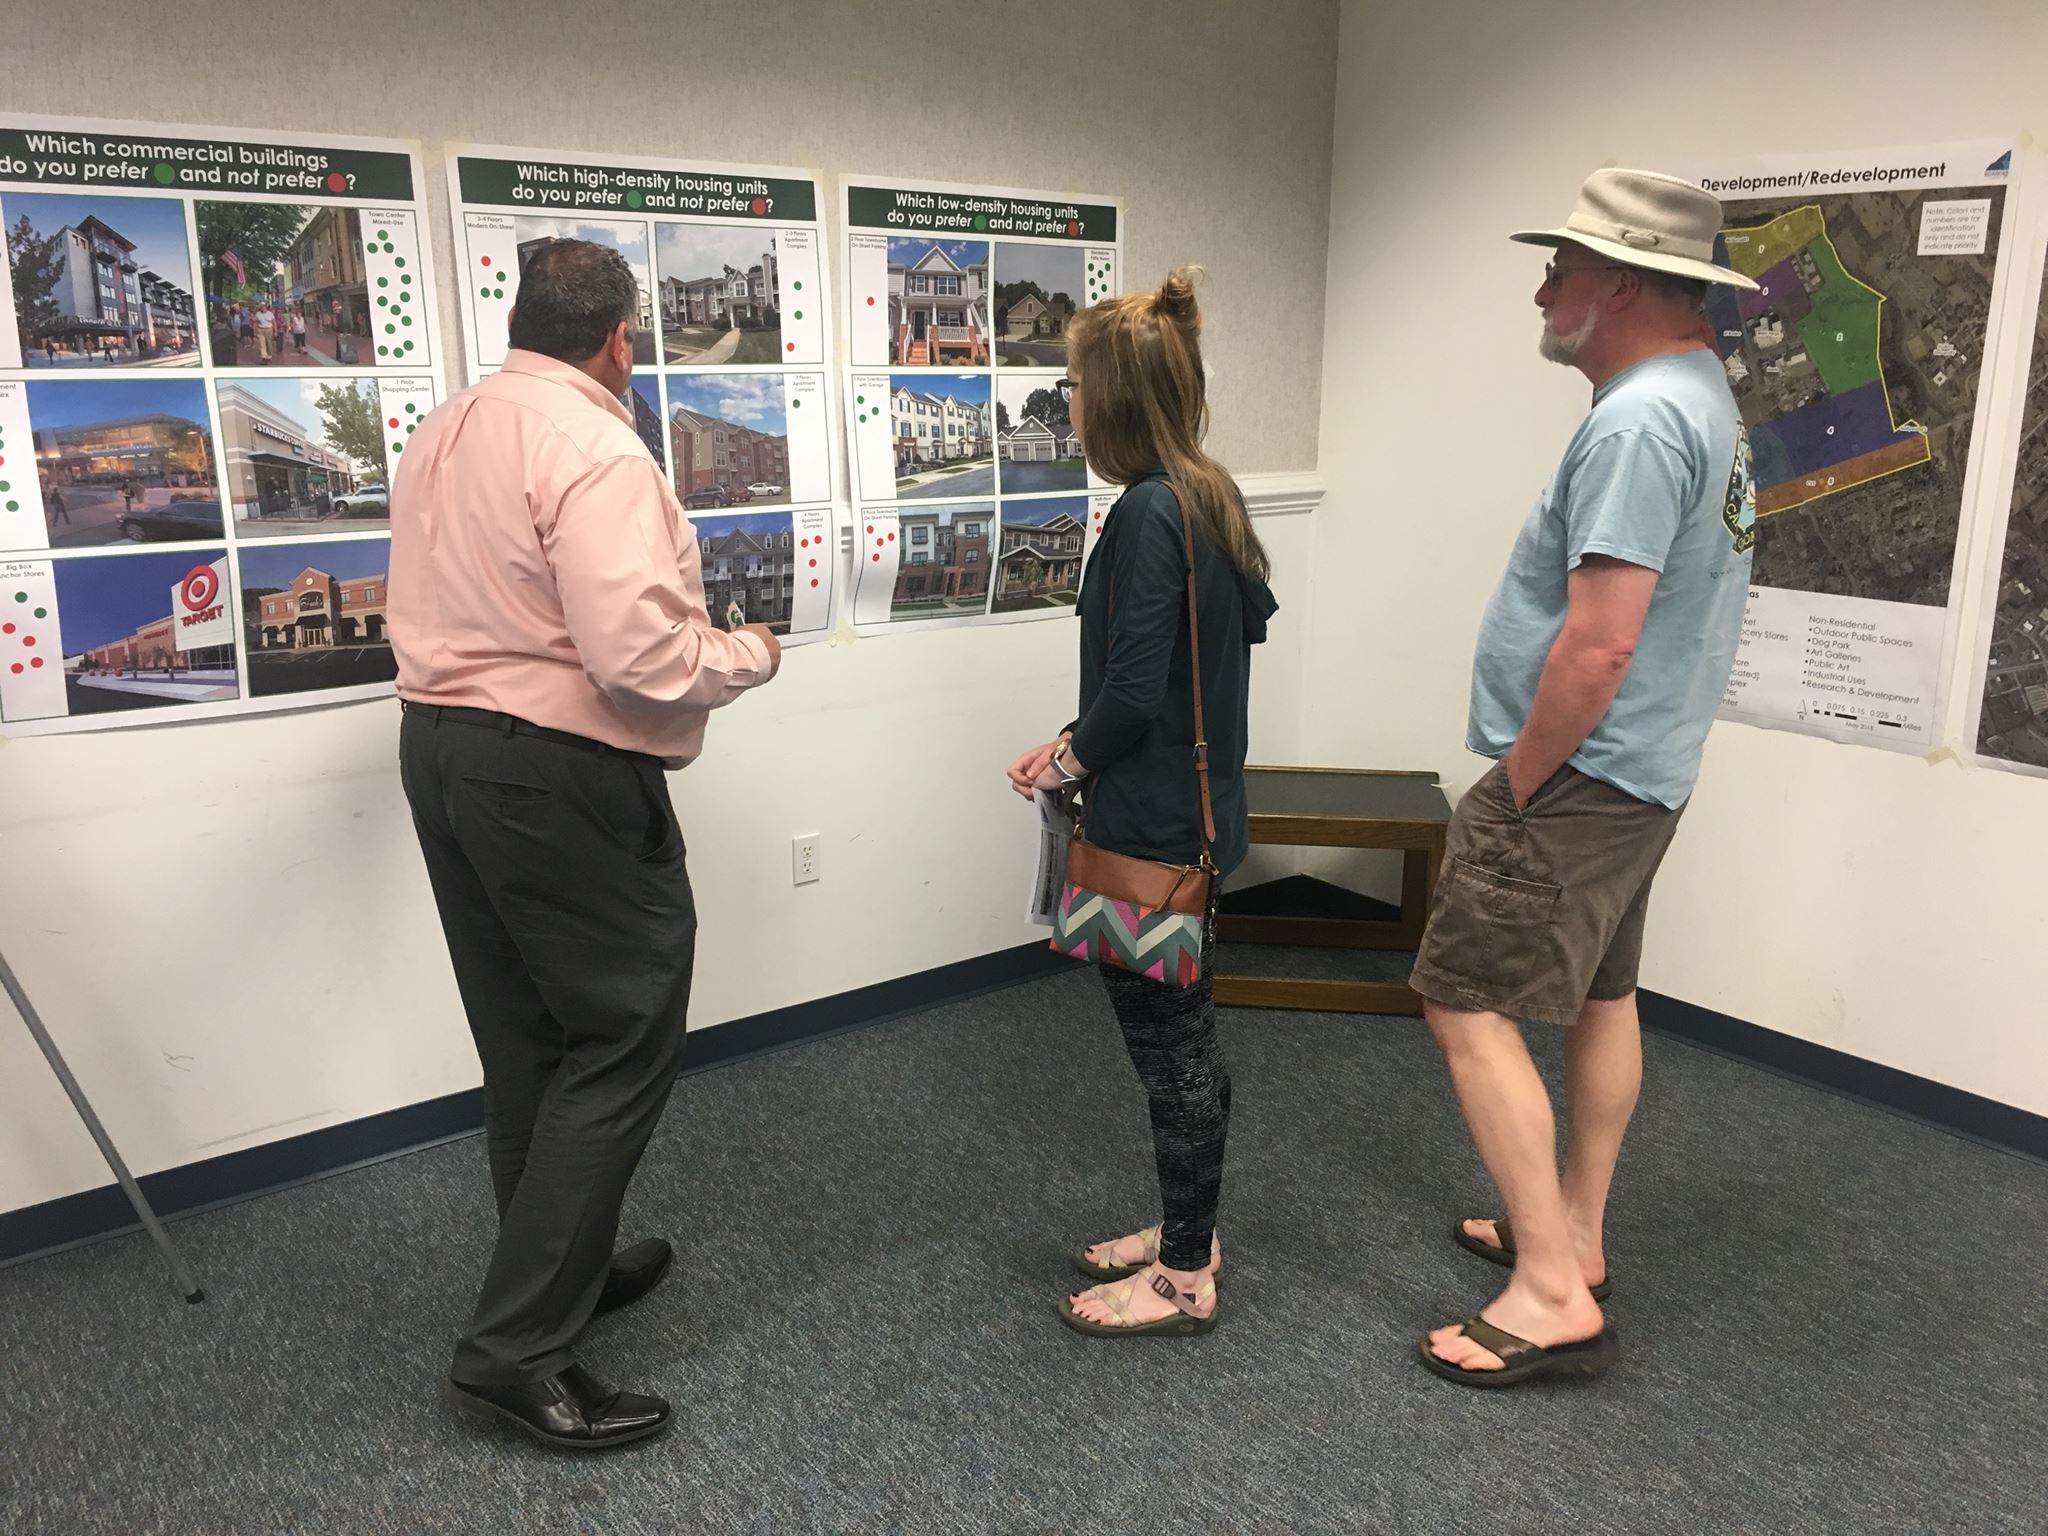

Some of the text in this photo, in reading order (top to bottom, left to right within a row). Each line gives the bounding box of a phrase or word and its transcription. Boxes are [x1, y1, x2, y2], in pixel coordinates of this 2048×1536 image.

[25, 134, 329, 172] Which commercial buildings
[0, 155, 27, 174] do
[34, 161, 77, 179] you
[84, 161, 148, 181] prefer
[180, 166, 221, 183] and
[228, 169, 260, 185] not
[266, 171, 324, 190] prefer
[517, 164, 768, 196] Which high-density housing units
[1701, 162, 1946, 192] Development/Redevelopment
[512, 184, 535, 200] do
[539, 188, 571, 204] you
[575, 188, 623, 206] prefer
[645, 193, 676, 208] and
[680, 194, 704, 209] not
[707, 196, 750, 212] prefer
[895, 193, 1079, 220] Which low-density housing units
[887, 209, 905, 223] do
[908, 212, 932, 227] you
[935, 213, 972, 228] prefer
[989, 216, 1013, 230] and
[1015, 218, 1033, 231] not
[1035, 220, 1067, 235] prefer
[1926, 216, 1955, 224] numbers
[257, 423, 291, 445] STARBUCKS
[181, 604, 224, 627] TARGET
[1808, 616, 1876, 631] Non-Residential
[1764, 631, 1789, 641] Stores
[1811, 637, 1850, 650] Dog Park
[1813, 626, 1913, 648] Outdoor Public Spaces
[1809, 658, 1850, 672] Public Art
[1810, 648, 1862, 663] Art Galleries
[1807, 669, 1866, 685] Industrial Uses
[1806, 679, 1920, 704] Research & Development
[1826, 702, 1845, 712] 0.075
[1850, 706, 1866, 715] 0.15
[1869, 709, 1889, 719] 0.225
[1902, 723, 1921, 731] Miles
